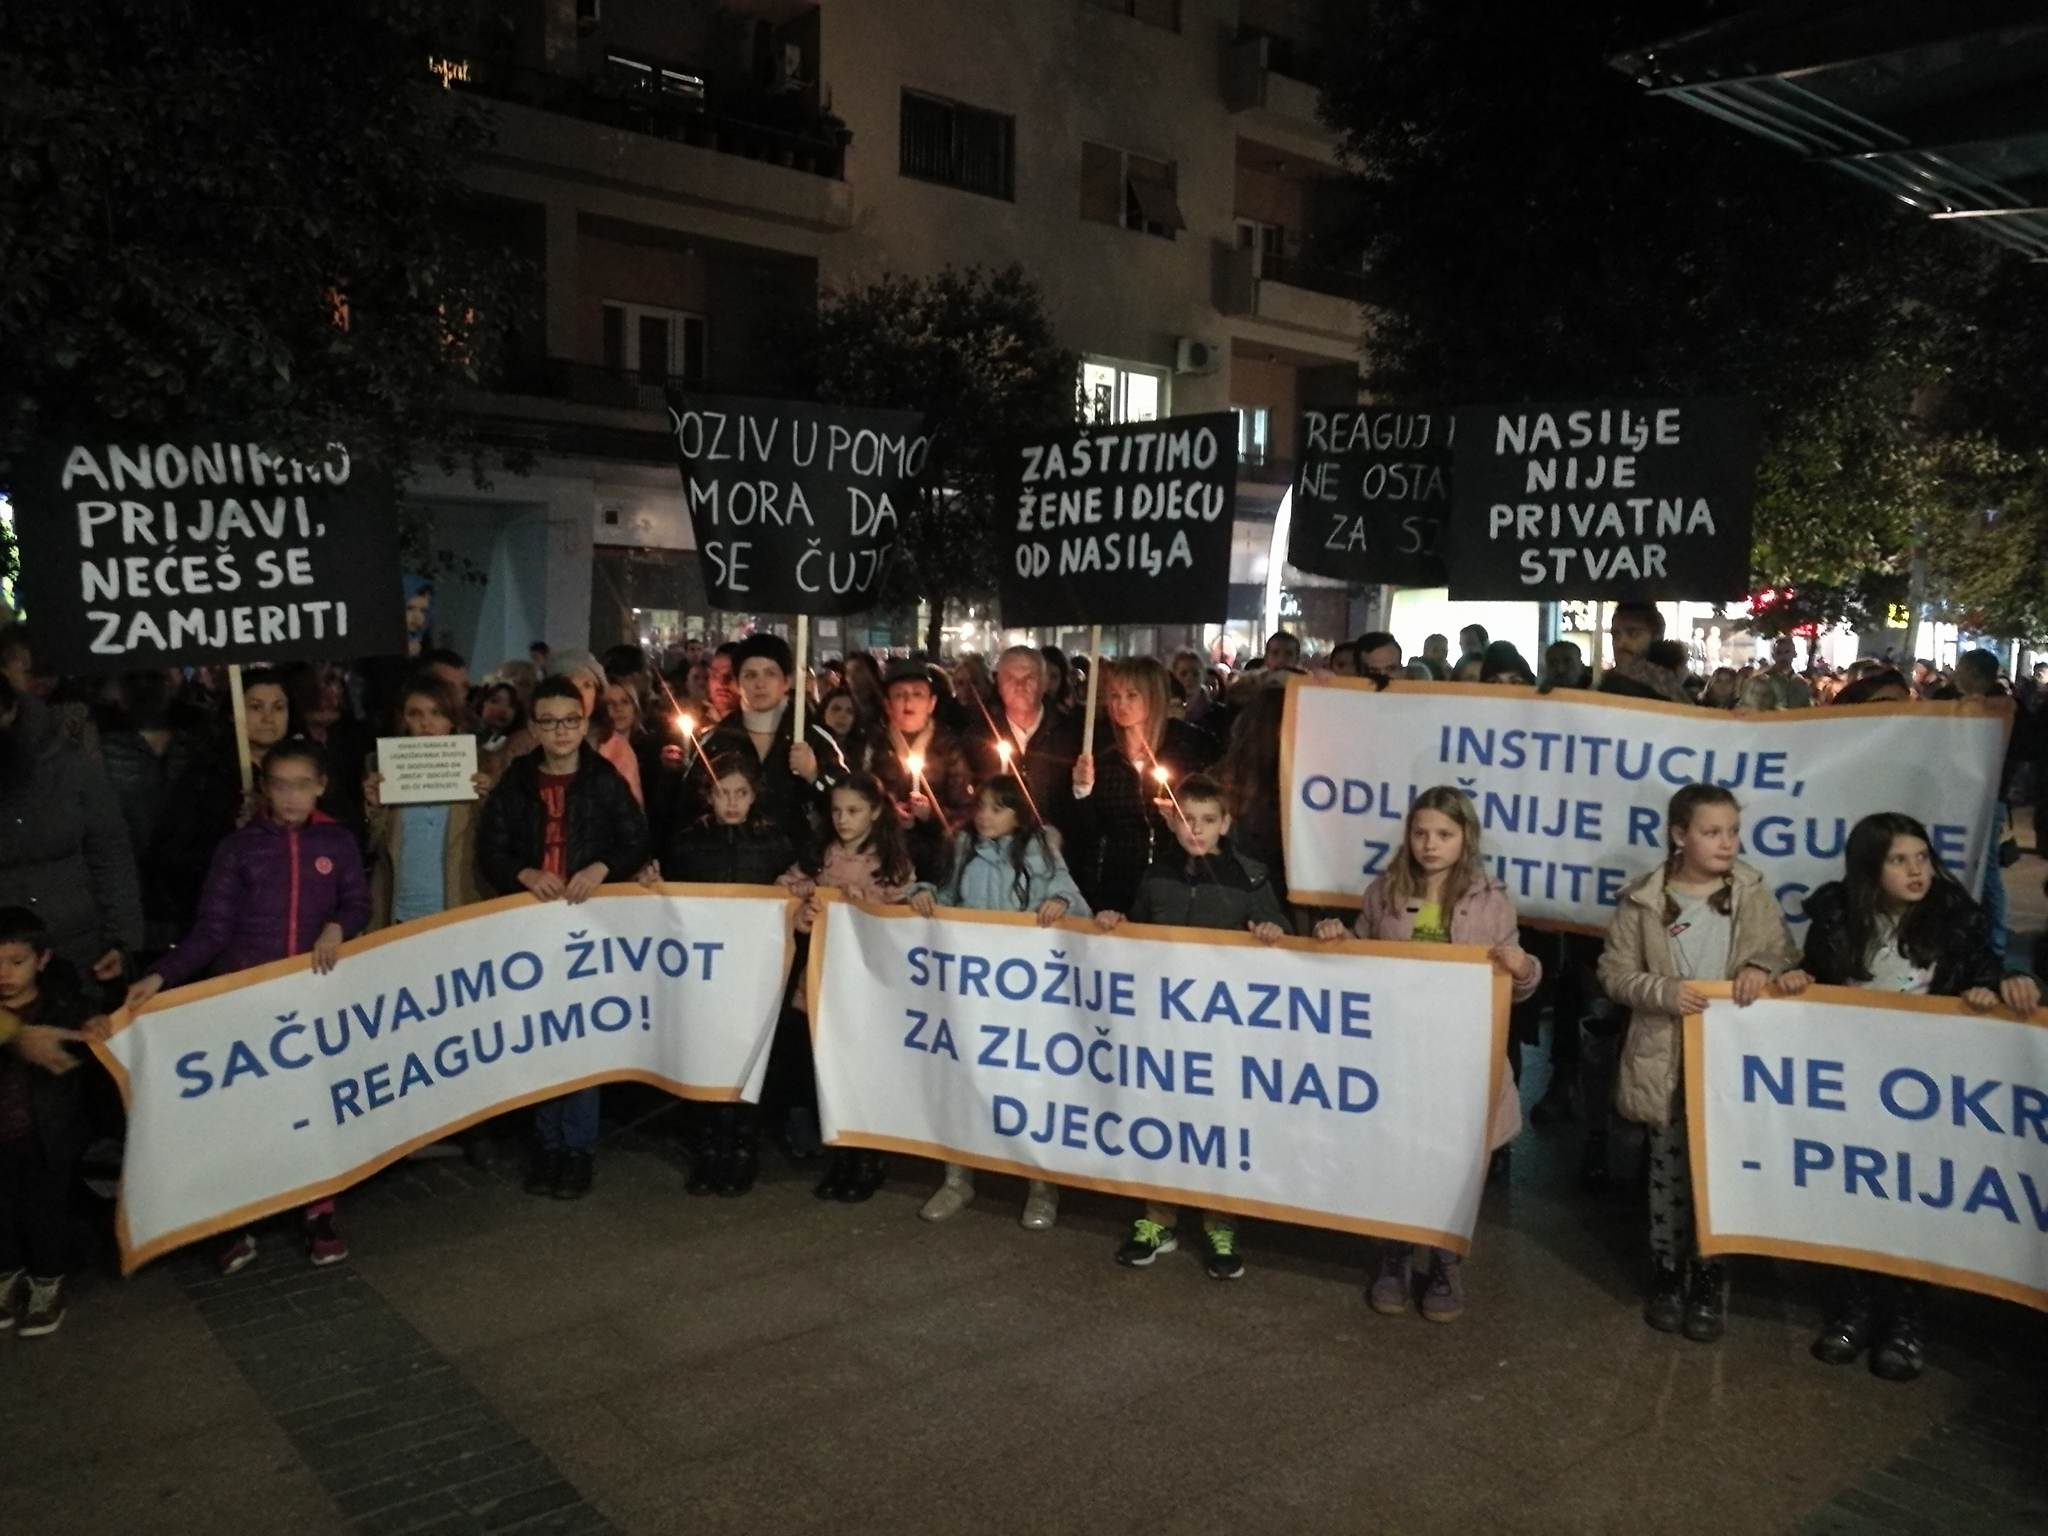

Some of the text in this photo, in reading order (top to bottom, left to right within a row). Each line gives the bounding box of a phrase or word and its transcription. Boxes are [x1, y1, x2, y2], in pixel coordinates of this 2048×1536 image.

[792, 419, 817, 467] U
[828, 424, 940, 478] POMO
[1021, 427, 1218, 482] ZAŠTITIMO
[1305, 411, 1432, 453] REAGUJ
[1300, 461, 1341, 501] NE
[1526, 455, 1636, 493] NIJE
[77, 496, 326, 548] PRIJAVI,
[690, 477, 898, 538] MORA DA
[1017, 480, 1224, 531] ŽENE I DJECU
[1490, 498, 1716, 541] PRIVATNA
[1325, 514, 1367, 552] ZA
[81, 544, 314, 603] NEĆEŠ SE
[705, 541, 752, 591] SE
[1016, 542, 1050, 579] OD
[1520, 544, 1667, 585] STVAR
[86, 601, 348, 654] ZAMJERITI
[1439, 725, 1805, 797] INSTITUCIJE,
[175, 929, 724, 1099] SAČUVAJMO ŽIVOT
[908, 945, 1373, 1039] STROŽIJE KAZNE
[330, 994, 651, 1126] REAGUJMO!
[904, 1008, 1379, 1115] ZA ZLOČINE NAD
[1742, 1055, 1846, 1112] NE
[992, 1094, 1251, 1171] DJECOM!
